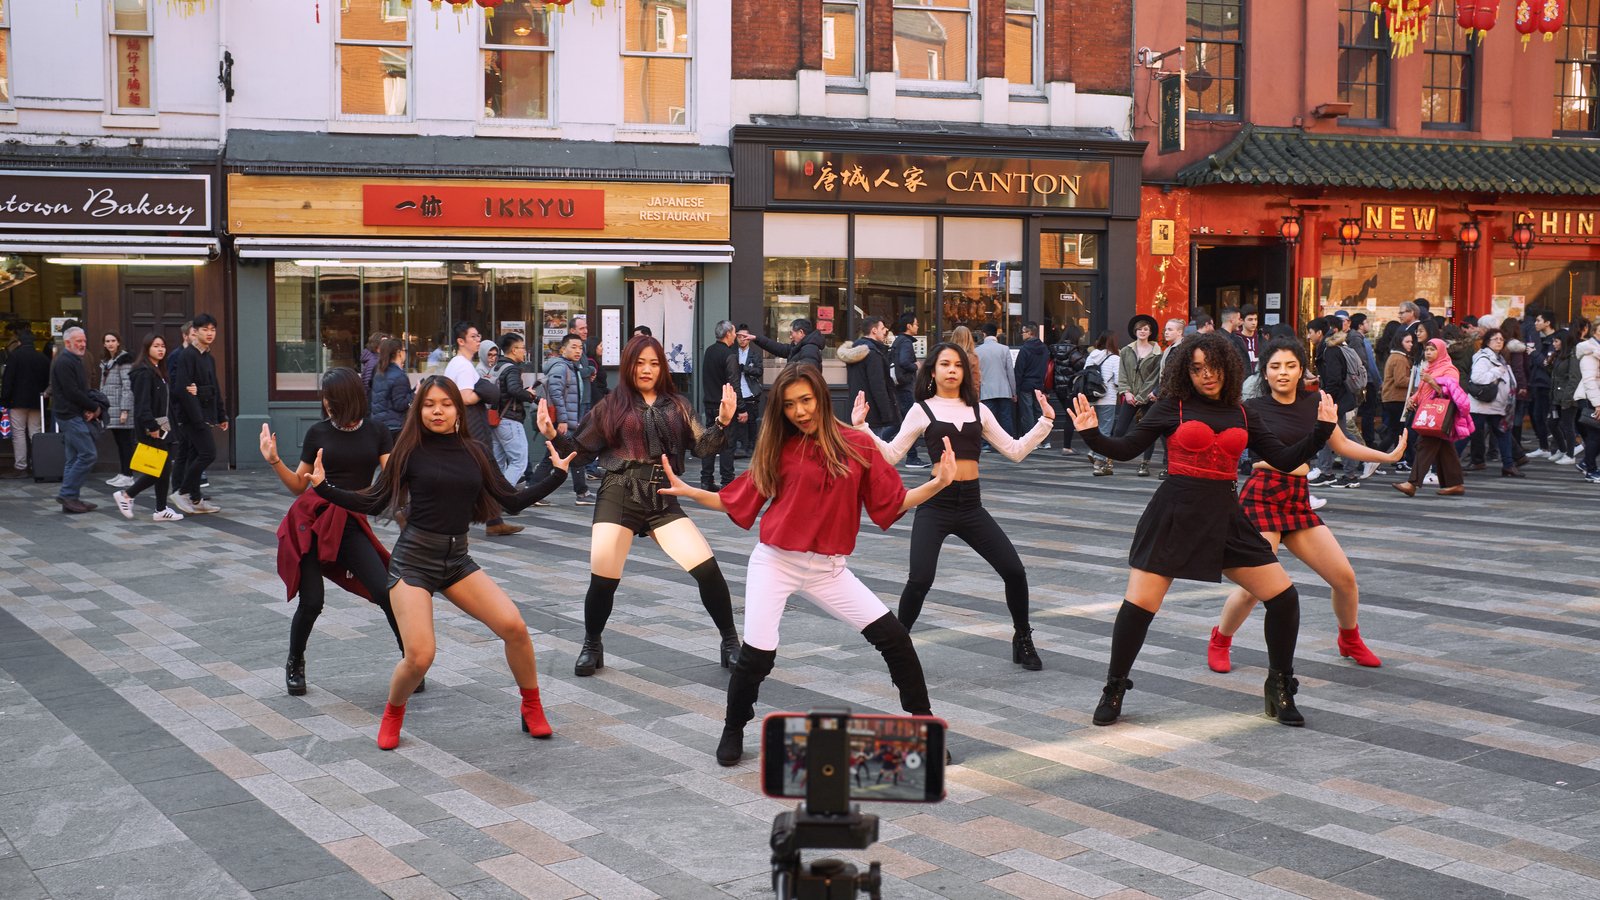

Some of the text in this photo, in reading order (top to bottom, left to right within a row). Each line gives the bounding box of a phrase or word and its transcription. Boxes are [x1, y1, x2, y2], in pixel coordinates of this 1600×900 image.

[813, 161, 929, 194] 唐城人家
[947, 169, 1083, 197] CANTON
[82, 188, 196, 225] Bakery
[396, 195, 444, 218] 一休
[485, 198, 576, 218] IKKYU
[647, 197, 705, 208] JAPANESE
[639, 210, 712, 222] RESTAURANT
[1365, 206, 1437, 231] NEW
